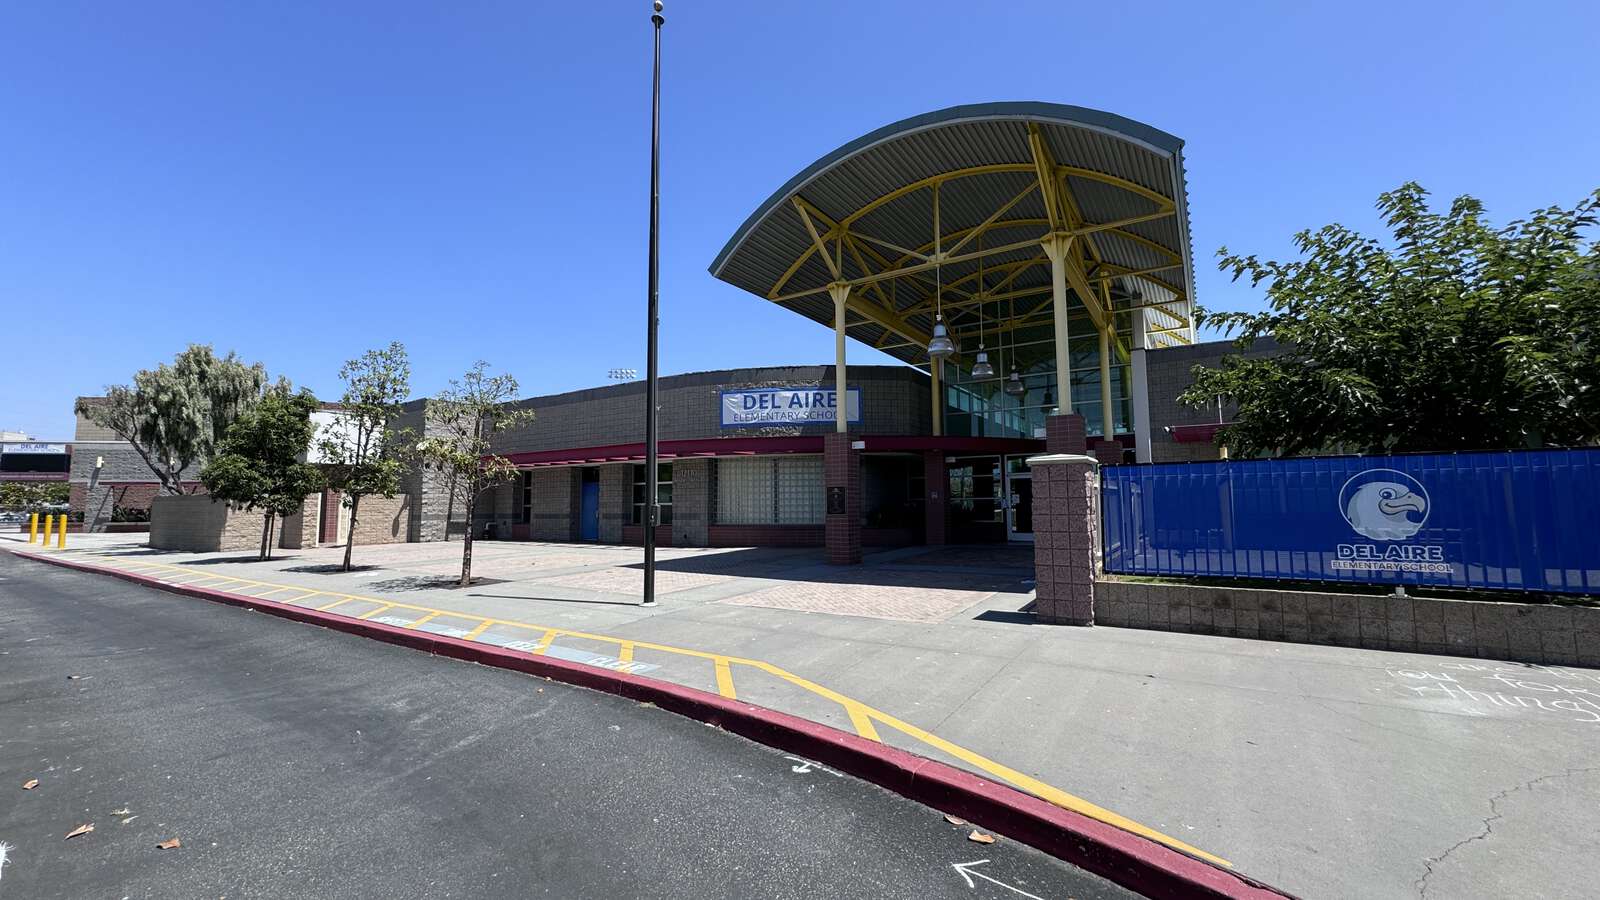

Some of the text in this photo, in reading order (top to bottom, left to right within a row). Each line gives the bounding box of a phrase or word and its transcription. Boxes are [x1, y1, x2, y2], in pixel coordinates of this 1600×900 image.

[743, 391, 837, 410] DEL AIRE
[733, 411, 800, 422] ELEMENTARY
[1337, 544, 1444, 562] DEL AIRE
[1331, 561, 1454, 573] ELEMENTARY SCHOOL
